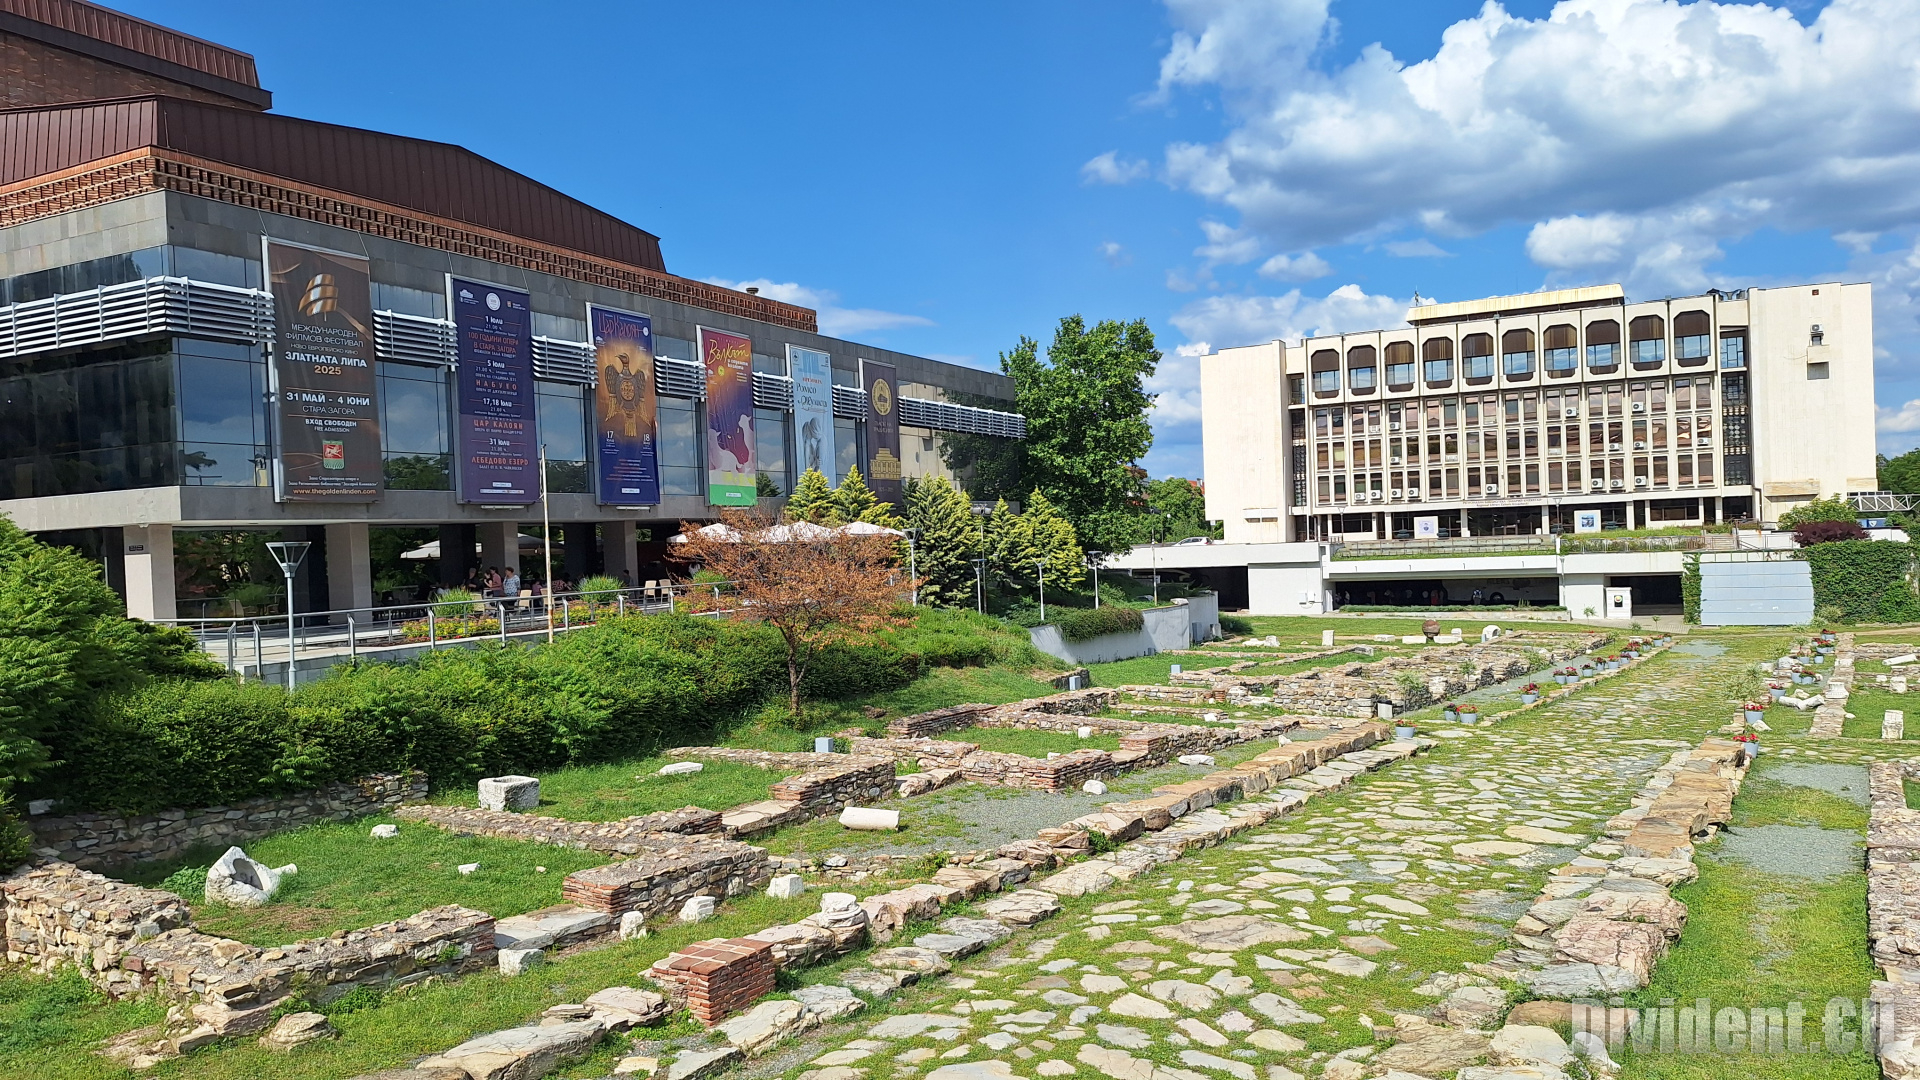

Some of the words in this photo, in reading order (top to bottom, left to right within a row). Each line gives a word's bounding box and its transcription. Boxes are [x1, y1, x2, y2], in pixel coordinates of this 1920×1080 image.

[291, 323, 358, 338] МЕЖДУНАРОДЕН
[285, 332, 322, 343] ФИЛМОВ
[324, 336, 364, 348] ФЕСТИВАЛ
[468, 331, 479, 339] 100
[480, 333, 502, 343] ГОДИНИ
[473, 341, 478, 349] В
[479, 342, 496, 352] СТАРА
[497, 345, 516, 354] ЗАГОРА
[285, 351, 338, 365] ЗЛАТНАТА
[340, 356, 367, 367] ЛИПА
[314, 365, 341, 375] 2025
[286, 392, 299, 401] 31
[302, 392, 326, 403] МАЙ
[337, 396, 343, 404] 4
[347, 397, 370, 406] ЮНИ
[483, 398, 499, 406] 17,18
[302, 405, 327, 414] СТАРА
[328, 406, 356, 415] ЗАГОРА
[305, 418, 323, 426] ВХОД
[324, 419, 357, 427] СВОБОДЕН
[493, 420, 523, 430] КАЛОЯН
[606, 430, 614, 439] 17
[643, 433, 651, 442] 18
[472, 456, 507, 465] ЛЕБЕДОВО
[508, 458, 529, 466] ЕЗЕРО
[293, 488, 376, 496] www.thegoldenlinden.com
